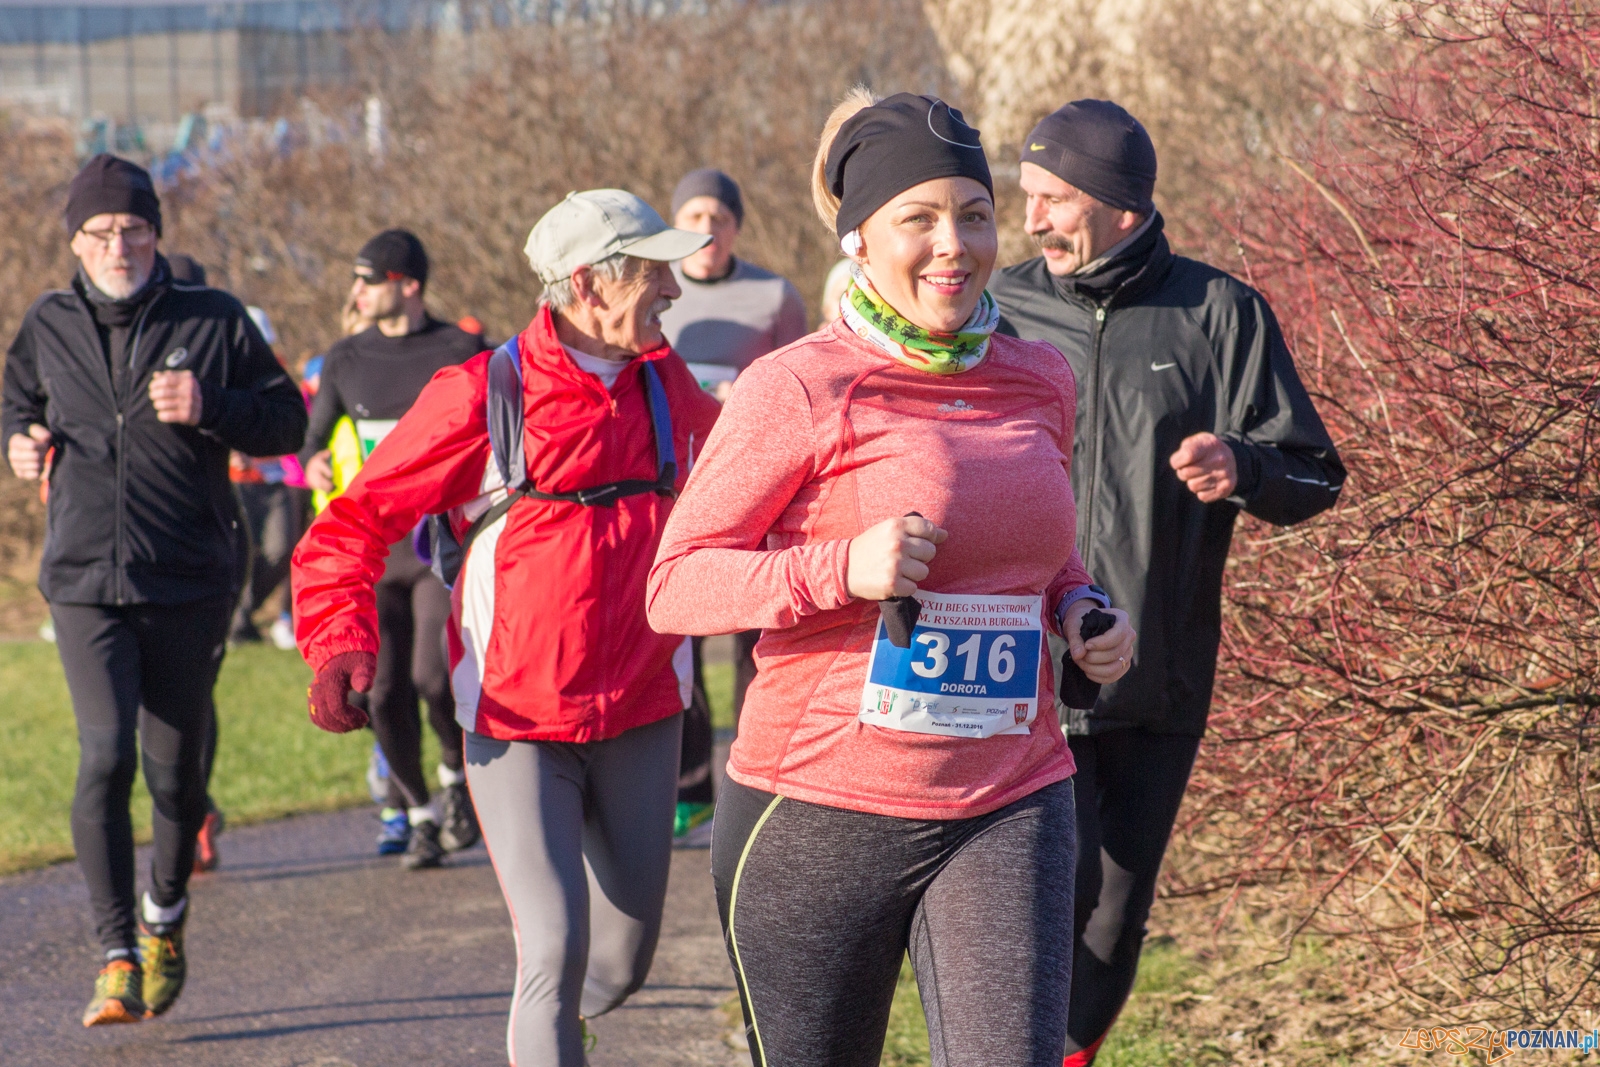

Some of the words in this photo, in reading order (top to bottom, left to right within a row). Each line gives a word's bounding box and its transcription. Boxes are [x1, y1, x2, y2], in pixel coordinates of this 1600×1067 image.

[945, 603, 969, 613] BIEG
[970, 603, 1033, 613] SYLWESTROWY
[918, 613, 931, 623] M.
[933, 615, 987, 626] RYSZARDA
[910, 631, 1017, 682] 316
[940, 683, 987, 695] DOROTA
